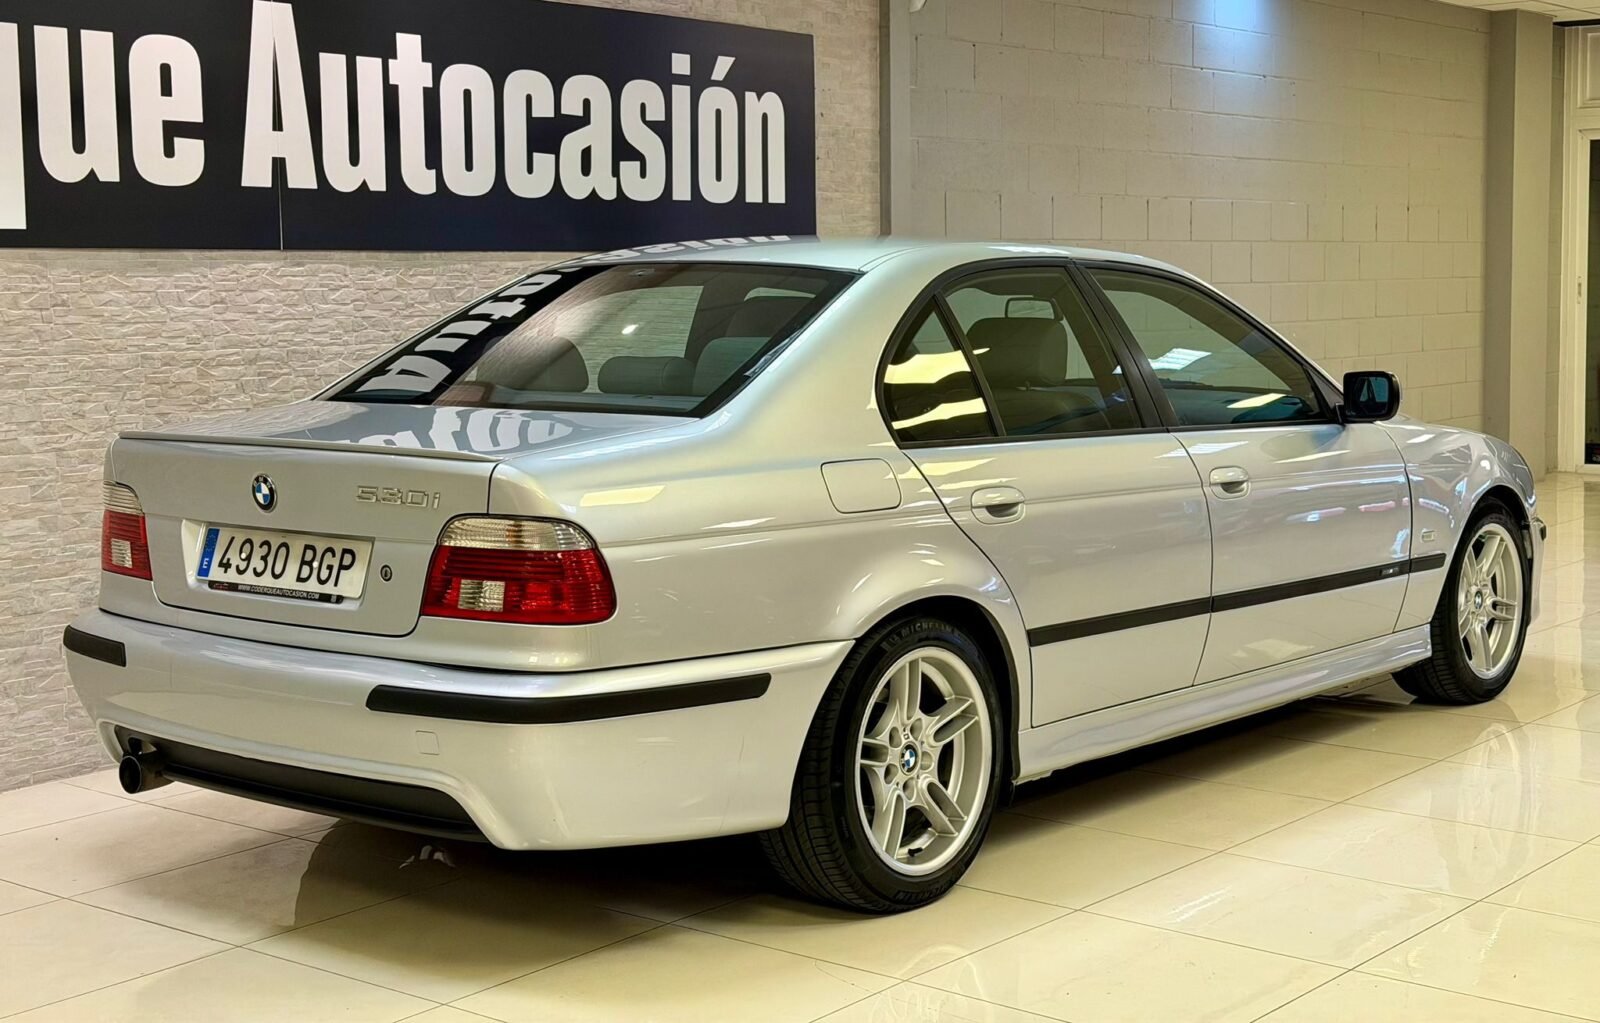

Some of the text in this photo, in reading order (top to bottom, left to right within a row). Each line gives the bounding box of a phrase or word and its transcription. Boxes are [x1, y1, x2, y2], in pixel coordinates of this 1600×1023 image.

[240, 0, 787, 204] Autocasión
[355, 485, 441, 509] 530i
[202, 558, 210, 569] E
[217, 535, 357, 588] 4930 BGP
